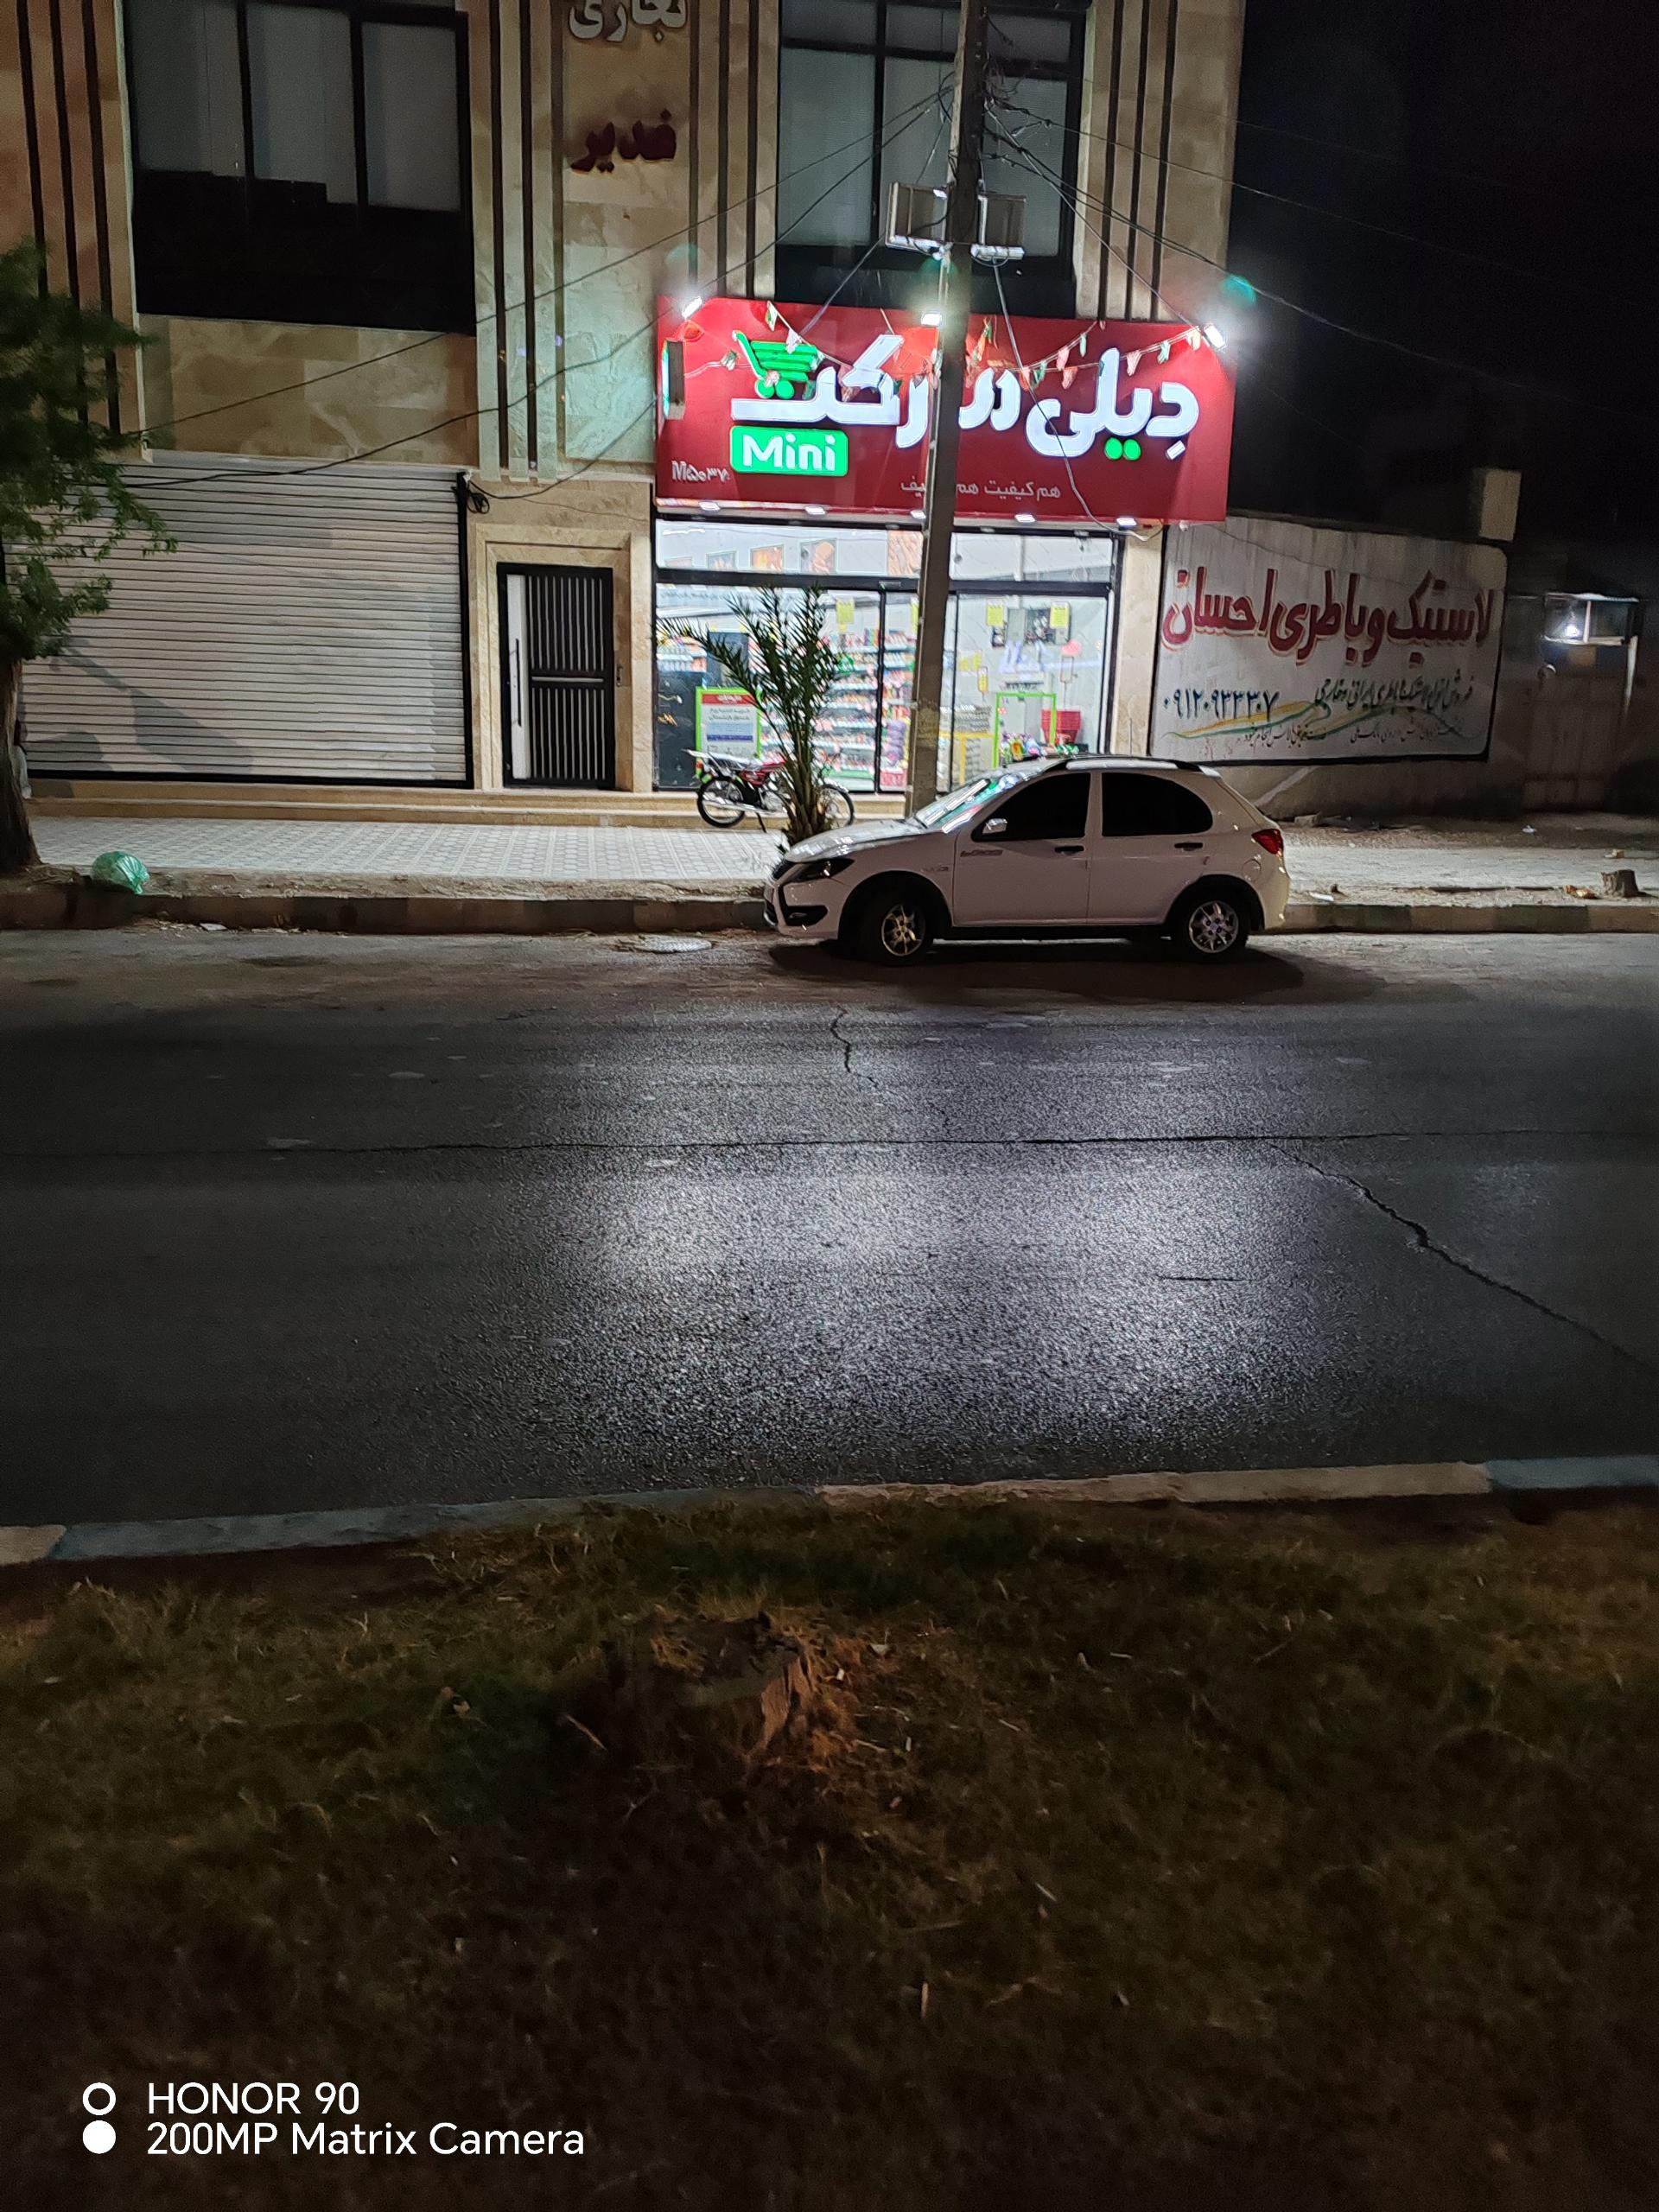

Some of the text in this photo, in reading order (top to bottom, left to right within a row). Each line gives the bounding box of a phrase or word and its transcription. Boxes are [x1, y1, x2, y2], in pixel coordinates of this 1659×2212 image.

[731, 334, 1021, 448] مرکت
[744, 434, 835, 470] Mini
[984, 480, 1034, 500] کیفیت
[1037, 484, 1060, 501] هم
[1162, 566, 1279, 651] احسان
[1387, 569, 1496, 669] لاستیک
